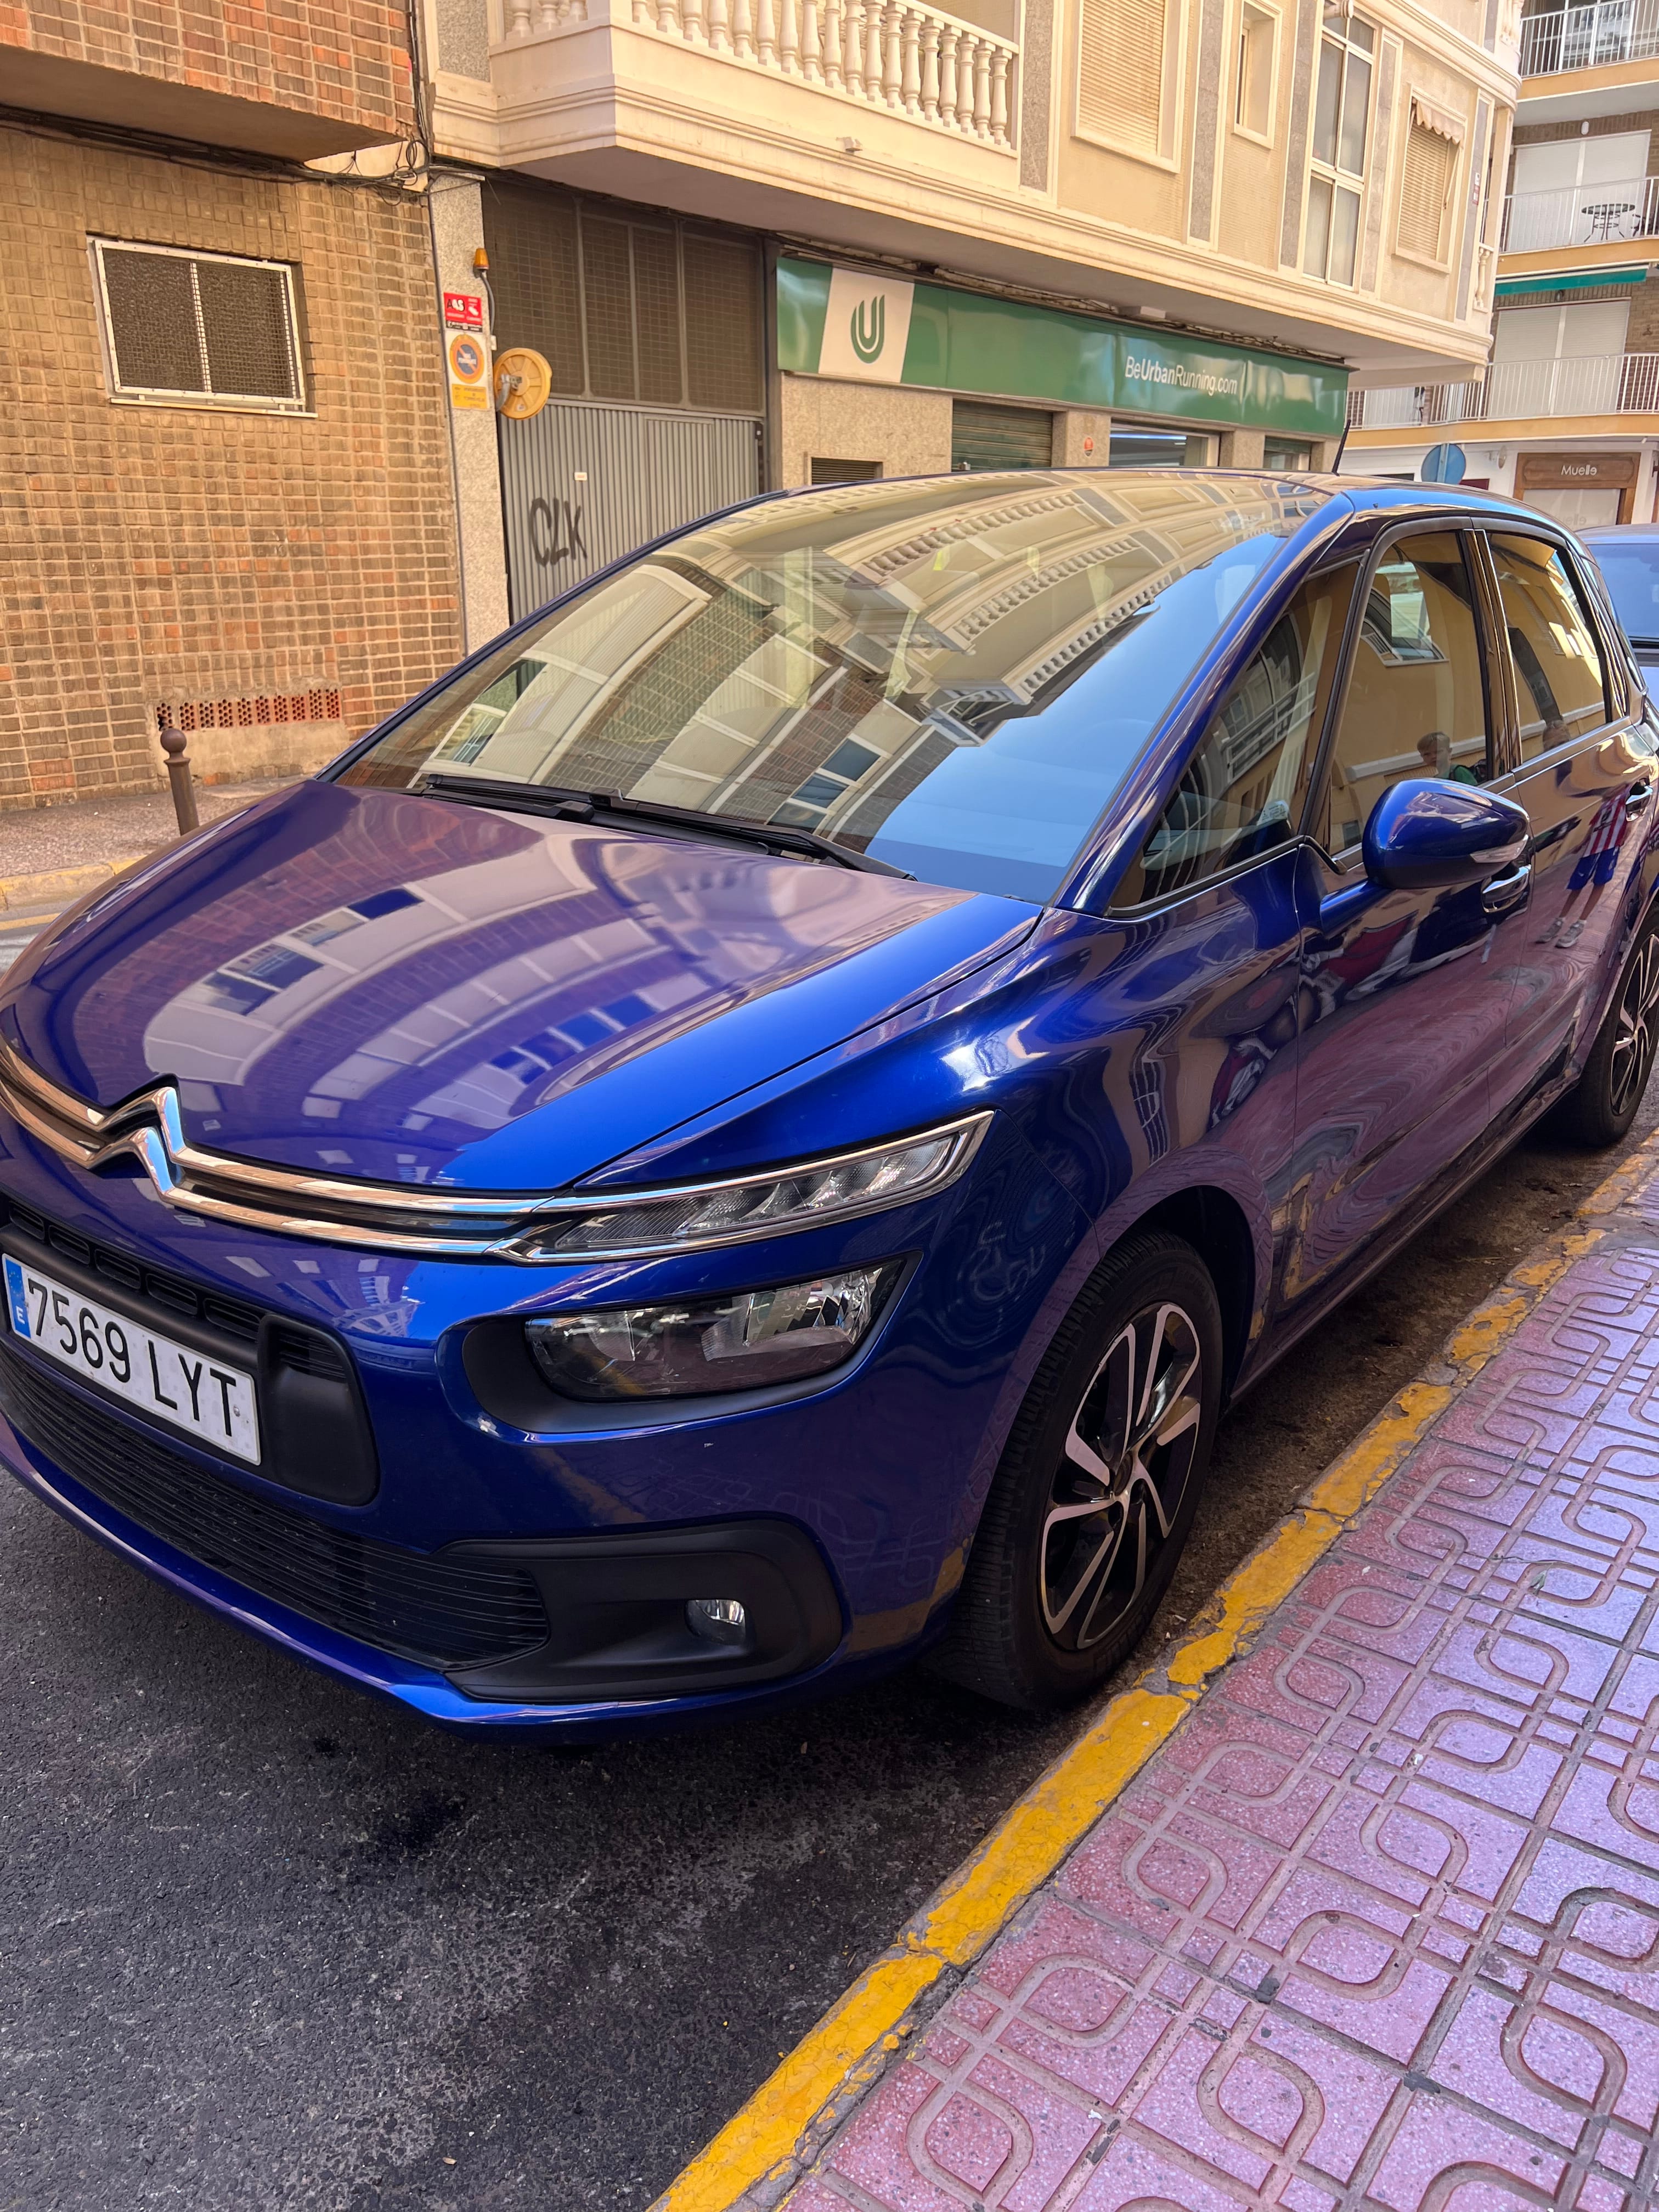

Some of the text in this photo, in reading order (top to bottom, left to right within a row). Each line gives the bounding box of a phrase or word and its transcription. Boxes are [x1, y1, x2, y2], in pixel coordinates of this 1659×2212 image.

[1125, 356, 1238, 396] BeUrbanRunning.com
[1561, 465, 1598, 476] Muelle
[16, 1305, 25, 1324] E
[28, 1277, 237, 1437] 7569 LYT
